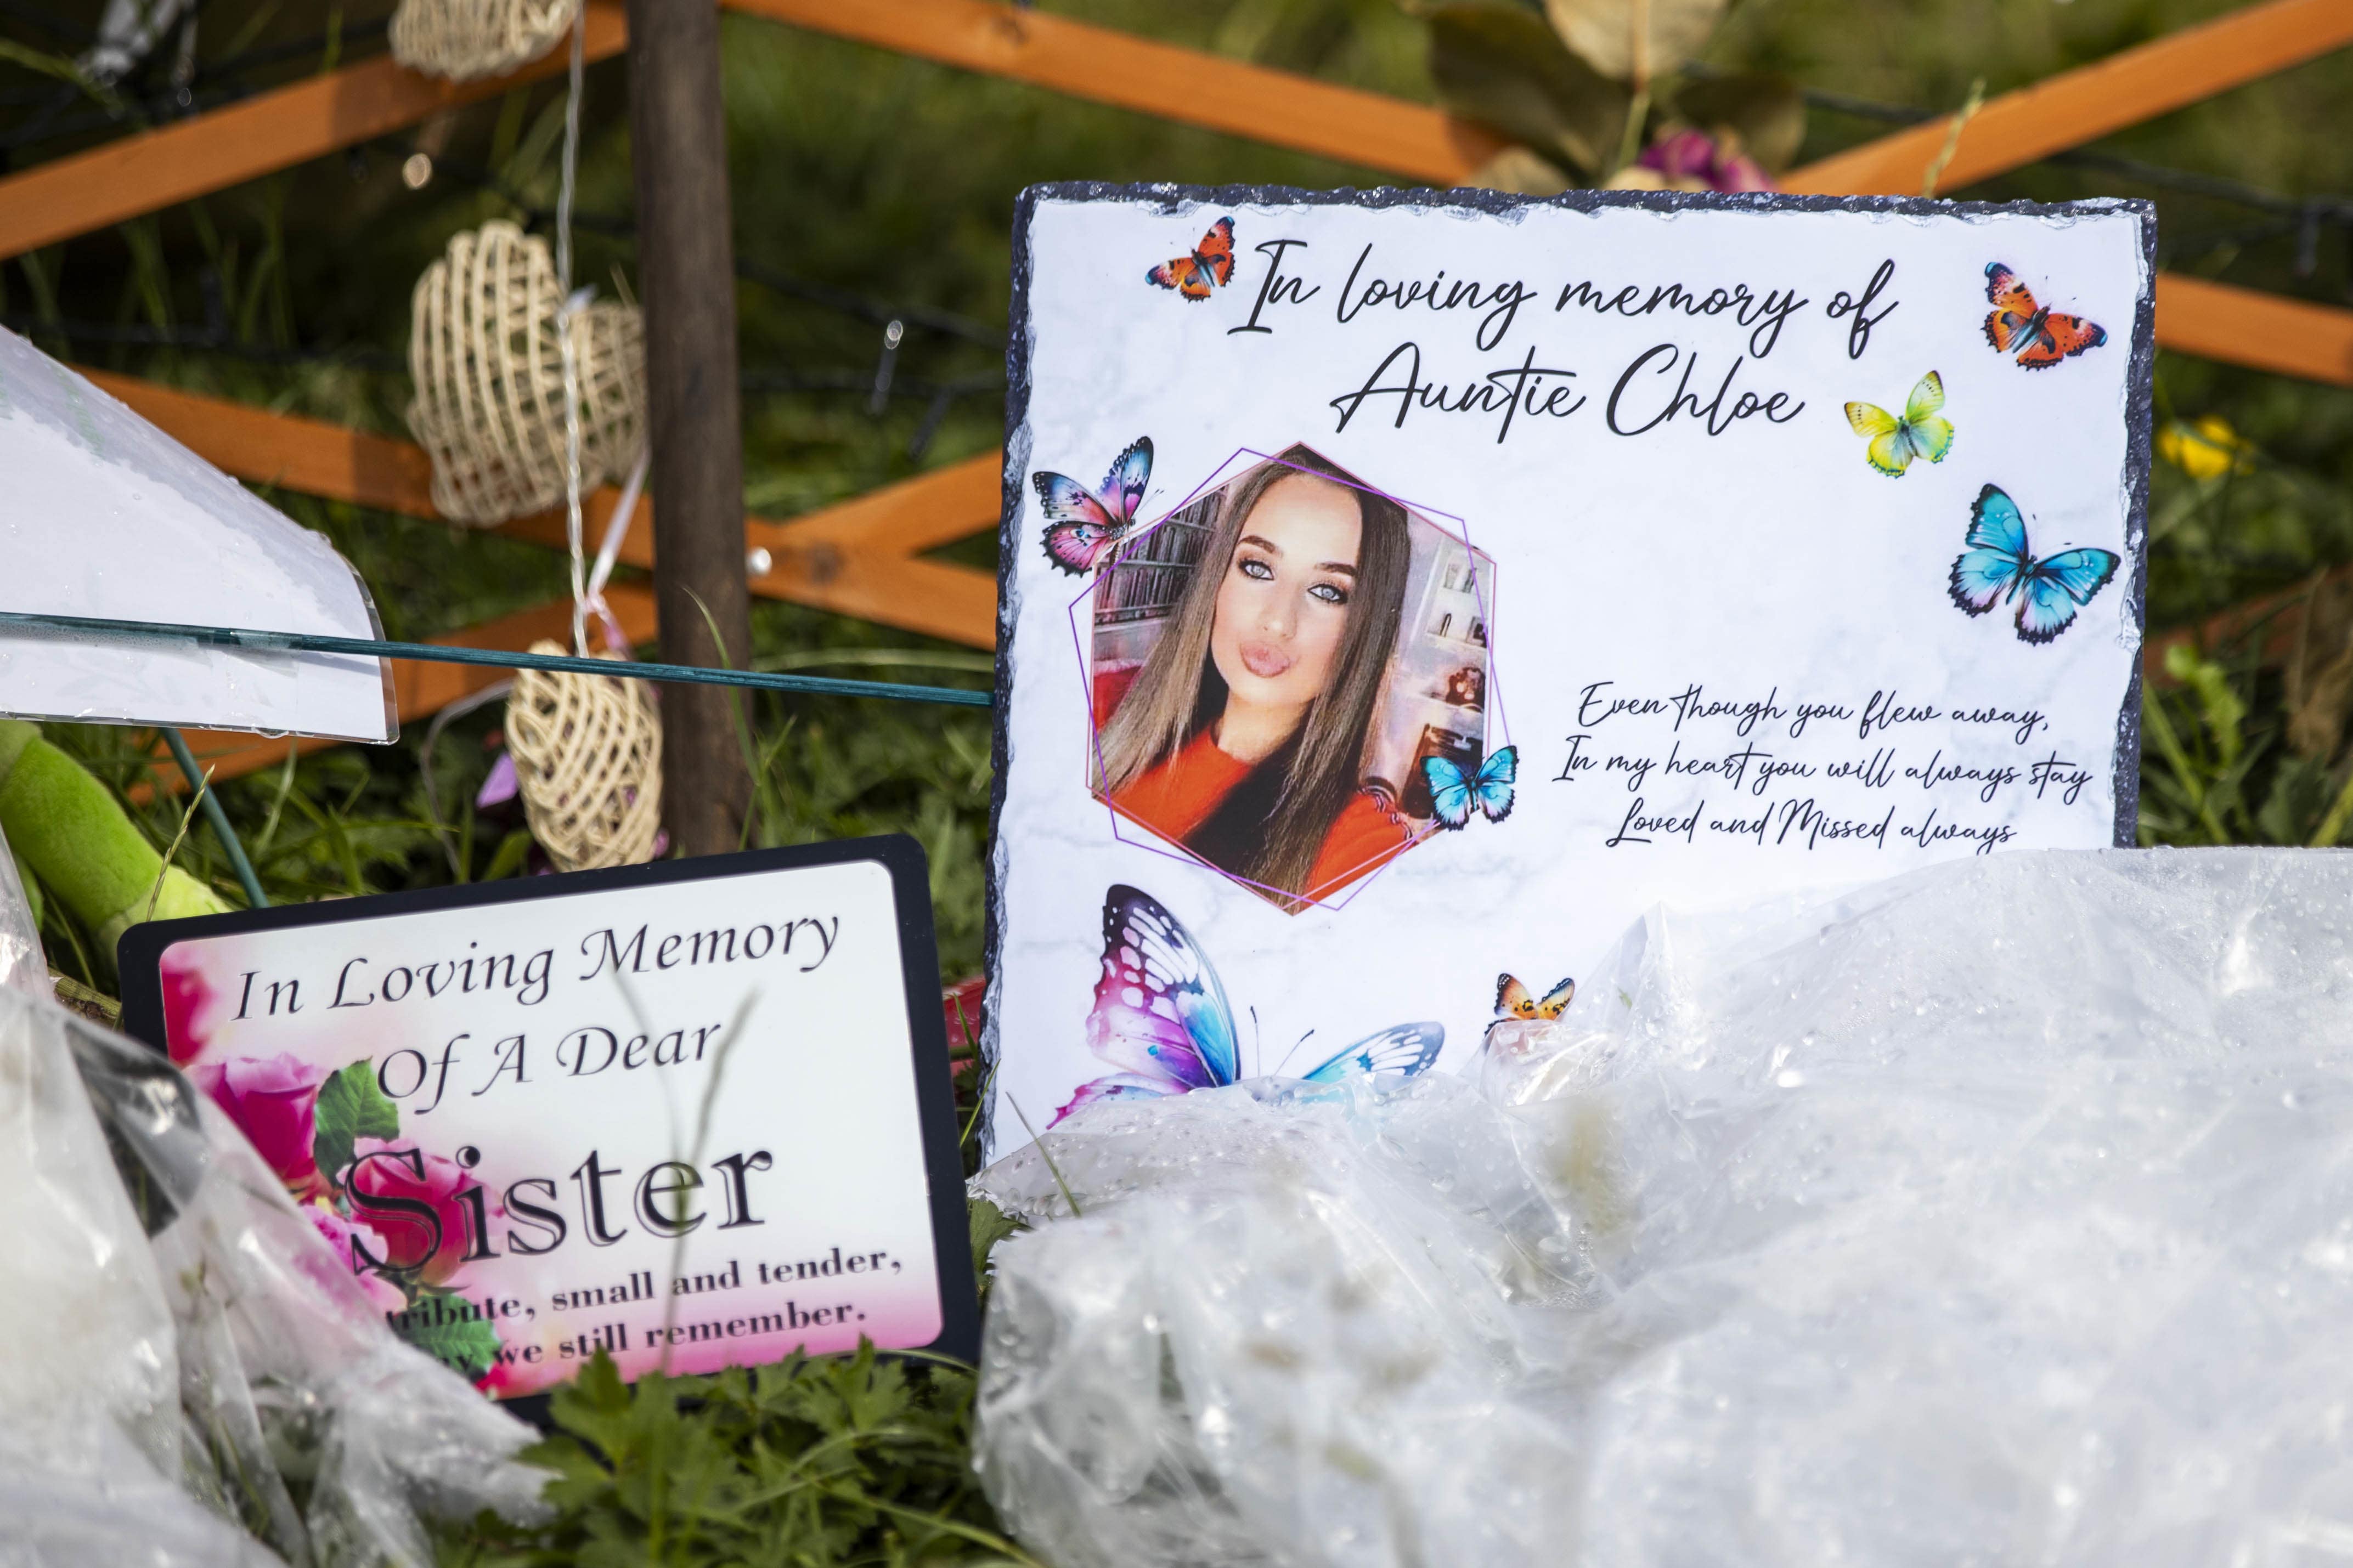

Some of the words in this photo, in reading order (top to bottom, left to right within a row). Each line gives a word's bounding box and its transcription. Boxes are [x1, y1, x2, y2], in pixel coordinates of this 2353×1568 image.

[1227, 239, 1321, 336] In
[1336, 242, 1538, 352] loving
[1555, 281, 1810, 359] memory
[1826, 258, 1900, 360] of
[1329, 341, 1587, 445] Auntie
[1606, 343, 1806, 437] Chloe
[1578, 681, 1668, 727] Even
[1669, 683, 1787, 737] though
[1790, 704, 1853, 738] you
[1859, 690, 1942, 740] flew
[1951, 707, 2049, 745] away,
[1551, 734, 1598, 783] In
[1605, 755, 1657, 792] my
[1665, 740, 1773, 790] heart
[1752, 761, 1817, 796] you
[1827, 748, 1896, 788] will
[1905, 750, 2022, 803] always
[2028, 750, 2094, 805] stay
[1605, 797, 1705, 848] Loved
[1709, 802, 1775, 846] and
[1777, 797, 1895, 850] Missed
[1900, 808, 2018, 855] always
[230, 970, 303, 1022] In
[327, 941, 555, 1005] Loving
[577, 914, 839, 982] Memory
[376, 1032, 471, 1115] Of
[471, 1034, 533, 1096] A
[556, 1023, 721, 1078] Dear
[342, 1144, 774, 1275] Sister
[386, 1297, 535, 1329] tribute,
[551, 1270, 656, 1312] small
[672, 1260, 742, 1297] and
[758, 1247, 902, 1286] tender,
[492, 1340, 543, 1368] we
[558, 1323, 630, 1360] still
[645, 1301, 867, 1349] remember.
